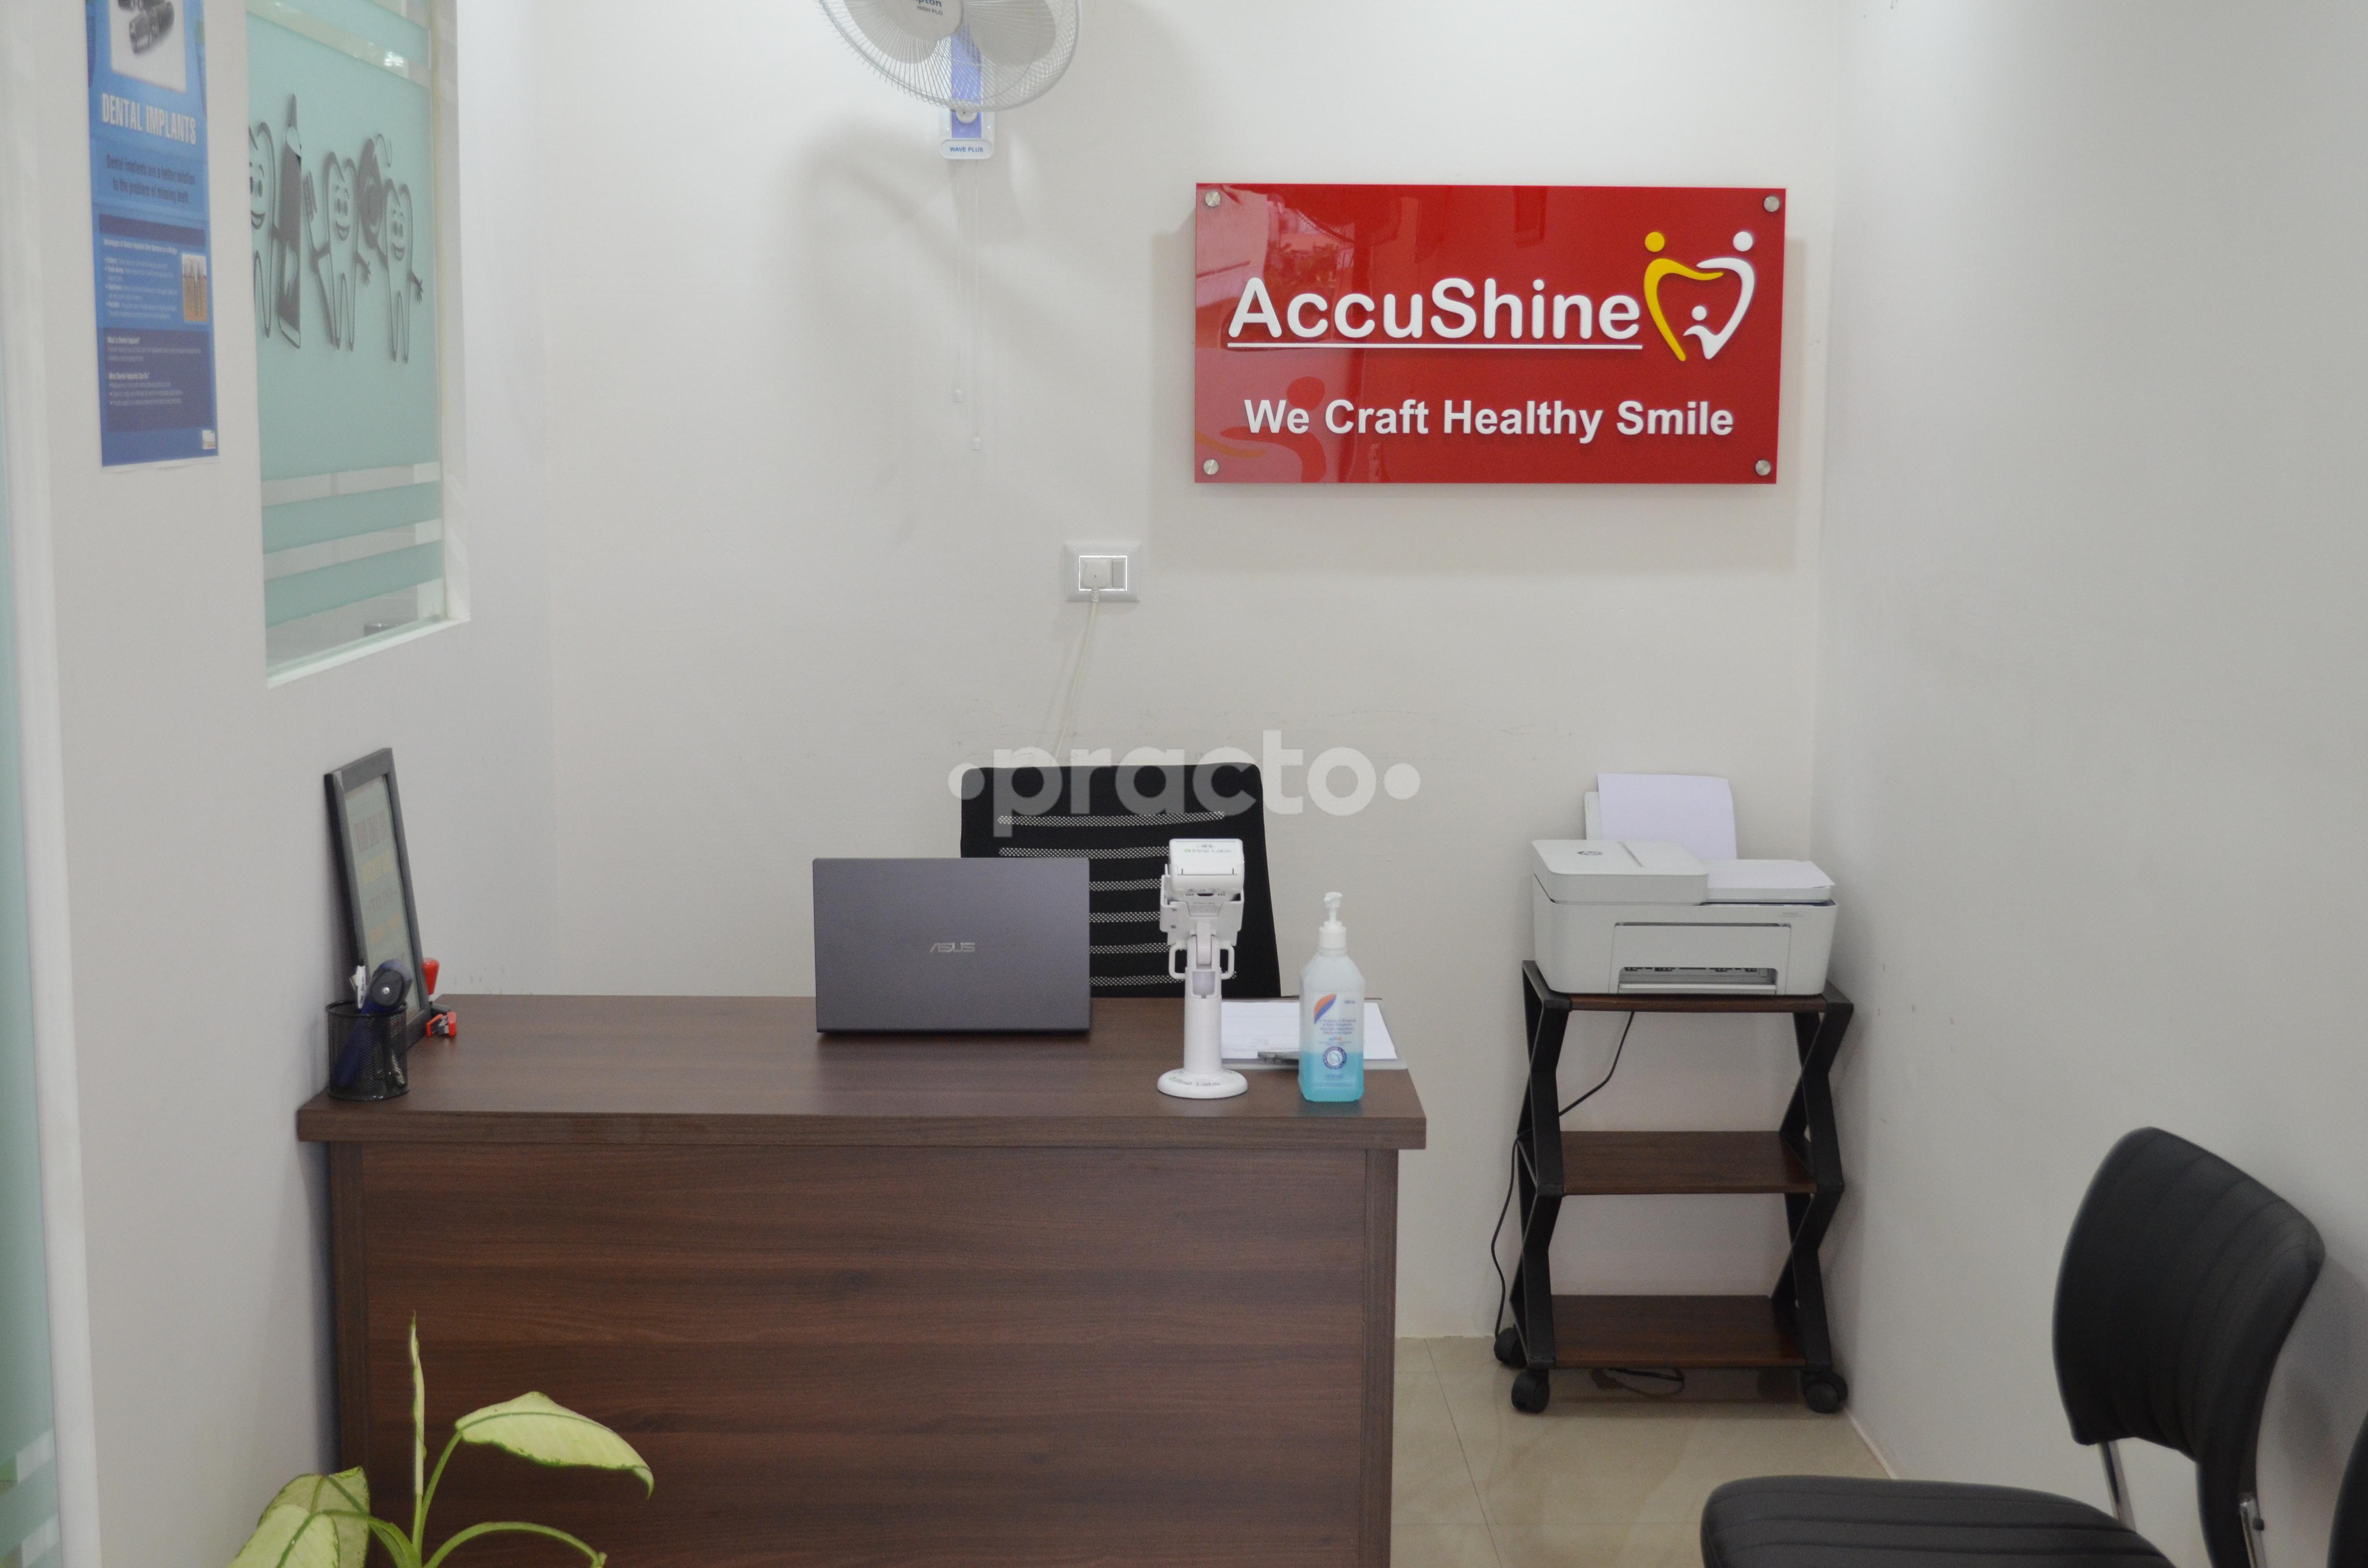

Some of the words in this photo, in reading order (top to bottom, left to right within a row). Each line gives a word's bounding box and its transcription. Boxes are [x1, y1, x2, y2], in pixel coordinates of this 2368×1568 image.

[102, 93, 143, 132] DENTAL
[146, 105, 197, 145] IMPLANTS
[1227, 277, 1640, 339] AccuShine
[1244, 399, 1310, 434] We
[1325, 399, 1429, 434] Craft
[1443, 400, 1603, 444] Healthy
[1616, 400, 1734, 435] Smile
[929, 942, 976, 953] ASUS
